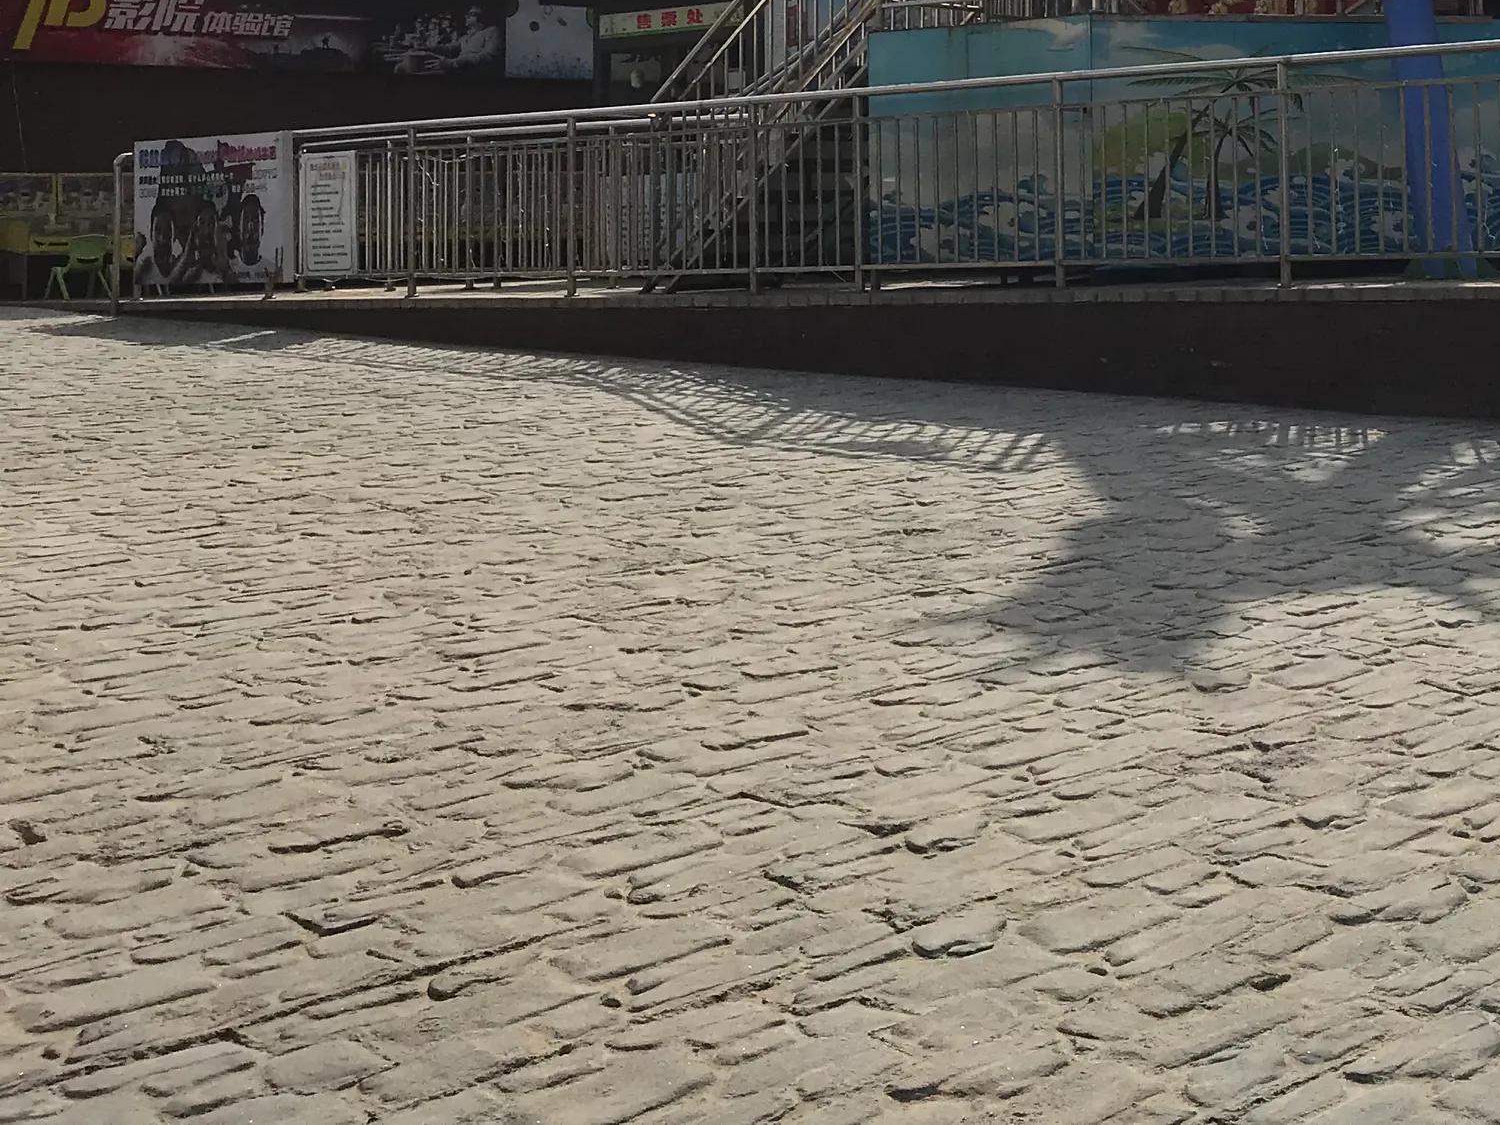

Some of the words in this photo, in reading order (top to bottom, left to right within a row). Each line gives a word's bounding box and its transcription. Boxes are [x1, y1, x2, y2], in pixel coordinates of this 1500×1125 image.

[201, 12, 294, 37] 体验馆
[636, 8, 704, 30] 售票处
